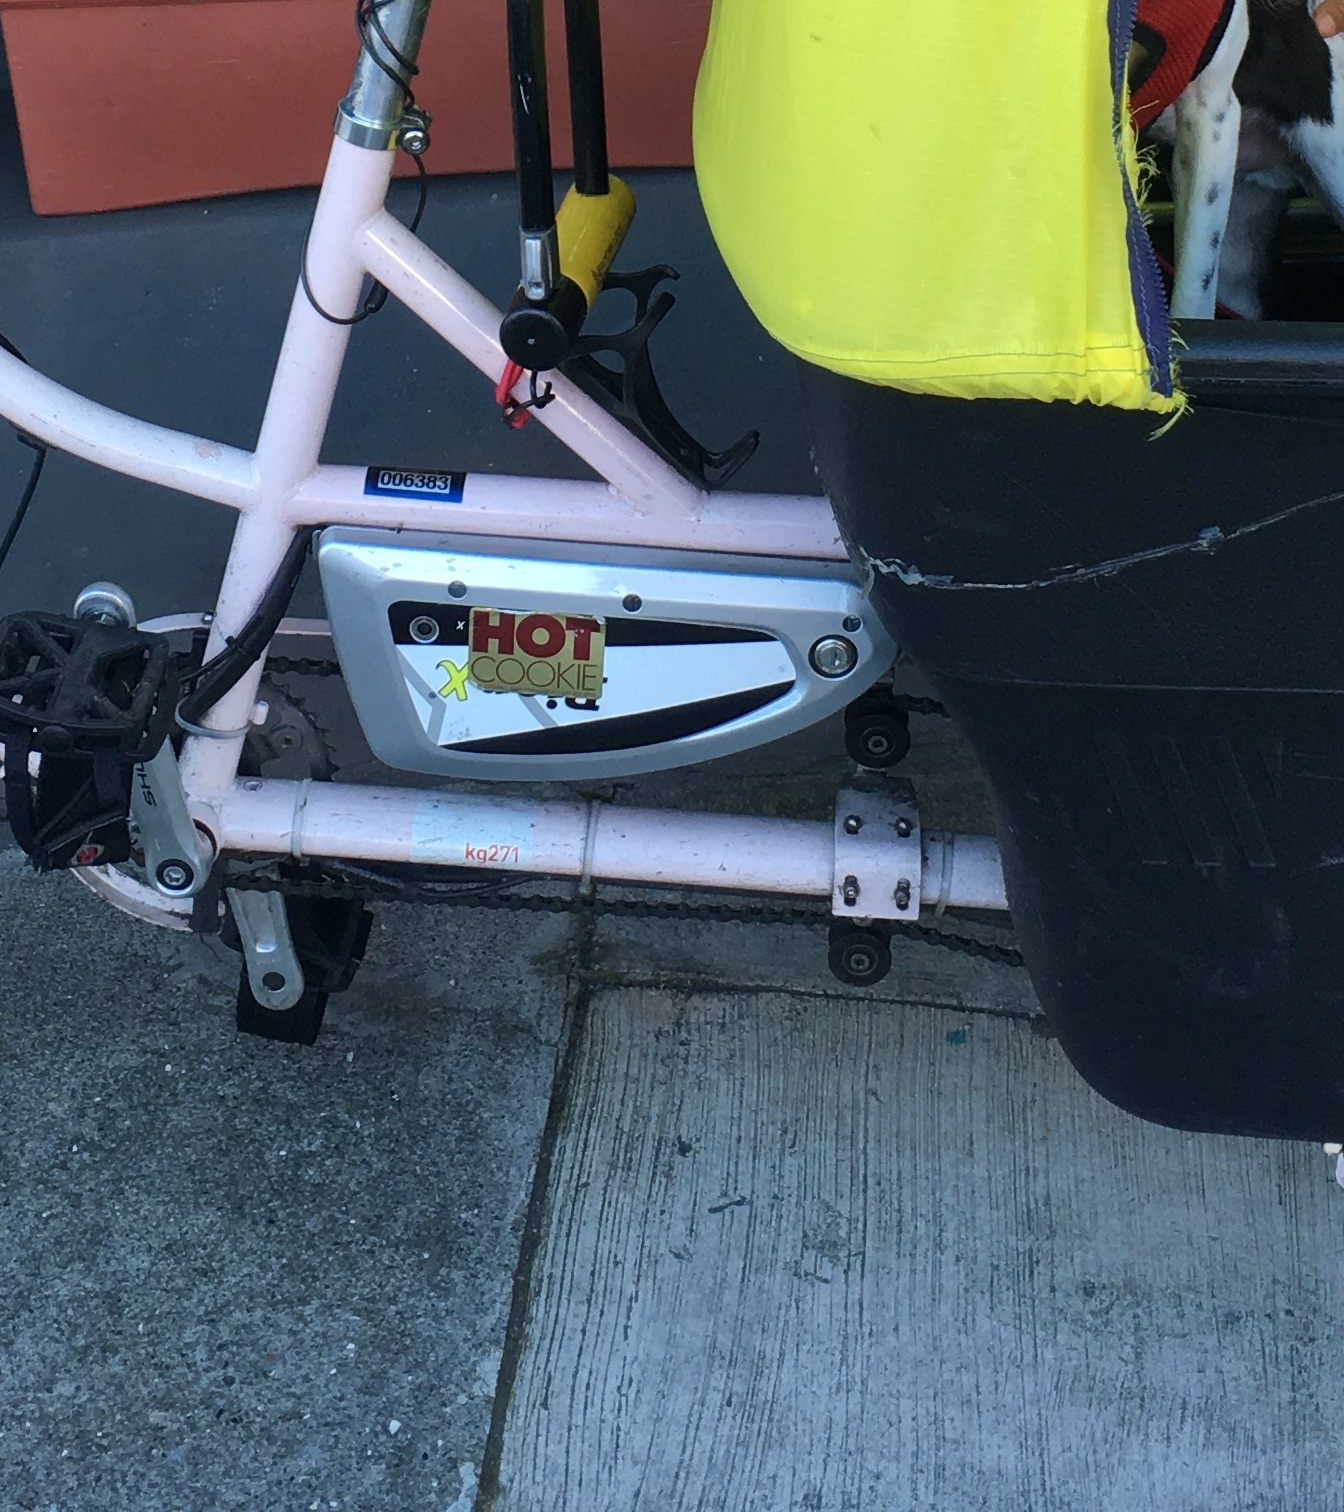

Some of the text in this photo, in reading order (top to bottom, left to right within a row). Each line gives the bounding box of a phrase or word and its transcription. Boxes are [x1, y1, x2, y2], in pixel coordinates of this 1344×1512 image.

[379, 470, 451, 491] 006383
[471, 608, 601, 662] HOT
[470, 655, 598, 692] COOKIE
[464, 842, 520, 863] kg271
